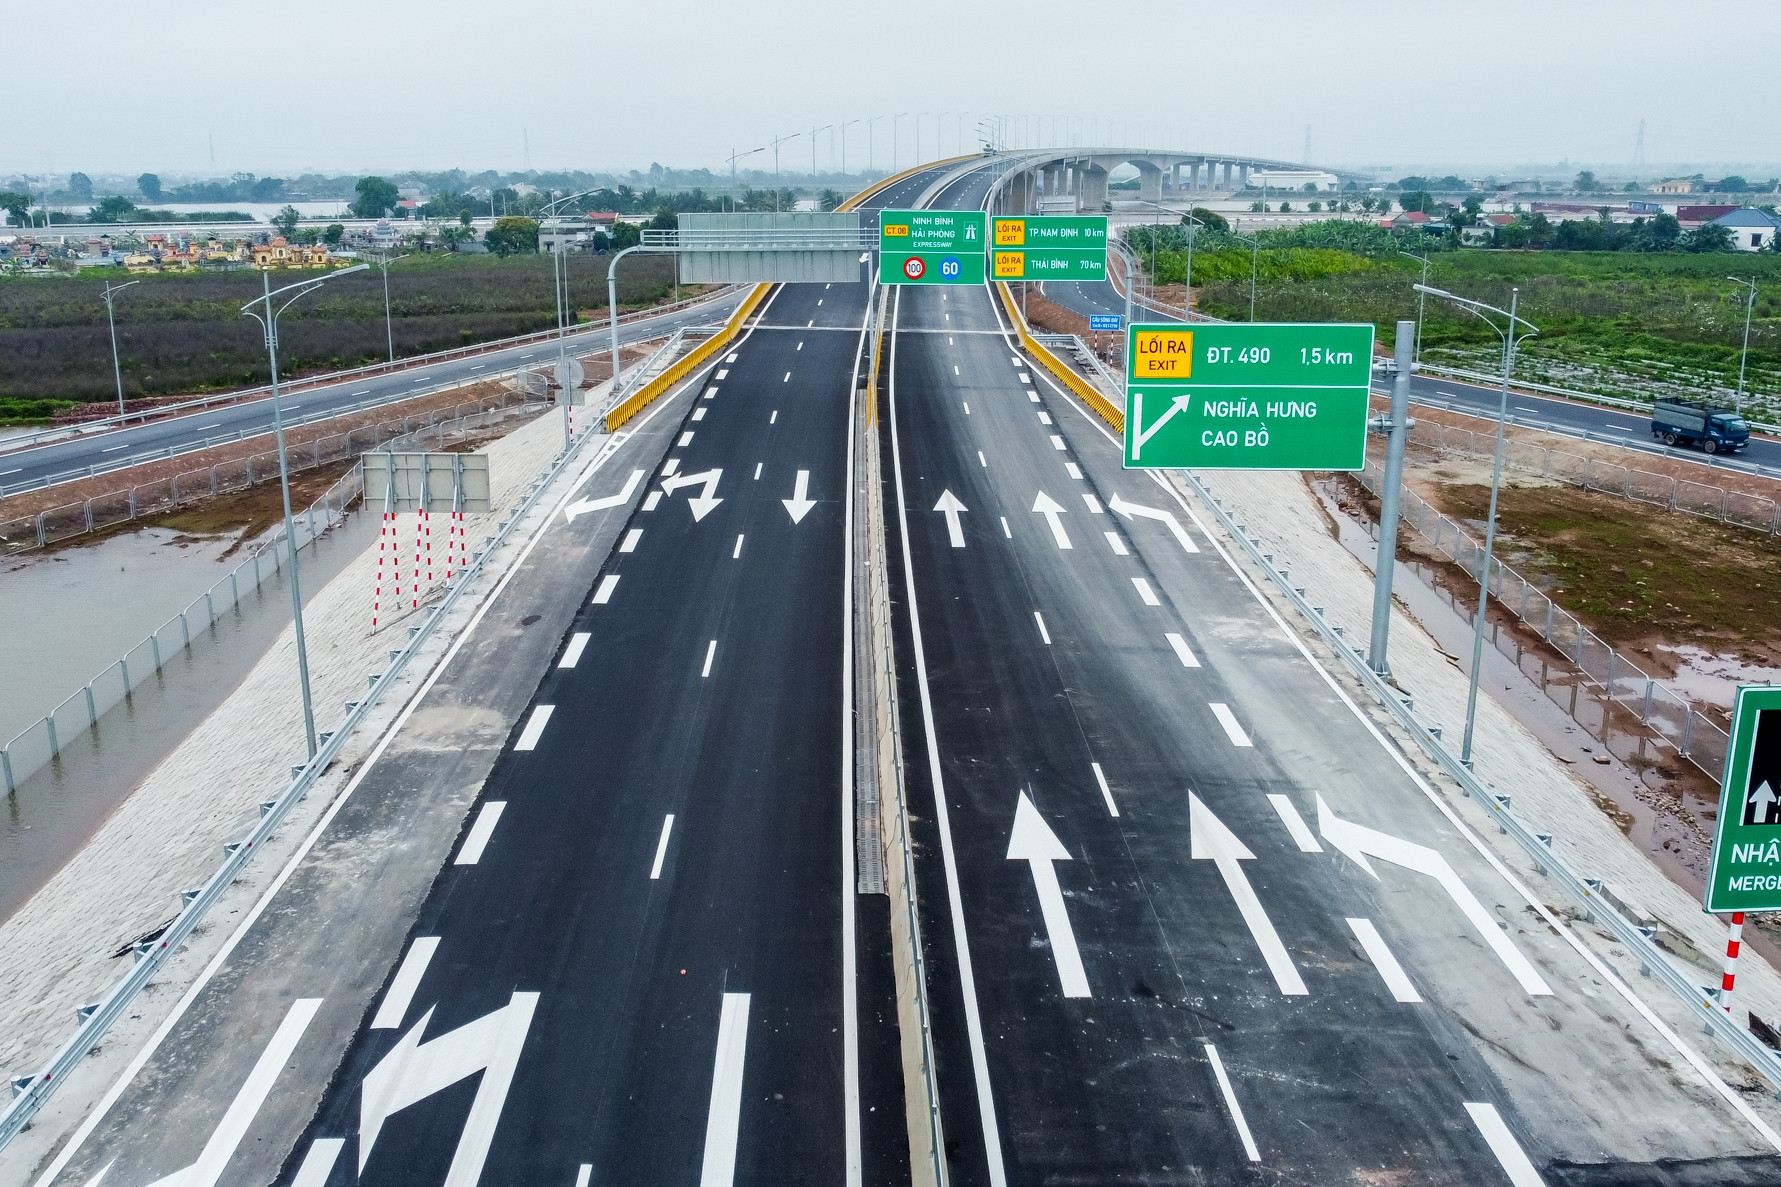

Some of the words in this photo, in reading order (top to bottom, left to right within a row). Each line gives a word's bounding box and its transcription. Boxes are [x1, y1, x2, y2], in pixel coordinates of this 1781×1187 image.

[912, 217, 932, 225] NINH
[934, 215, 954, 225] BÌNH
[911, 227, 926, 238] HẢI
[927, 228, 956, 238] PHÒNG
[997, 222, 1010, 233] LỐI
[1011, 225, 1022, 233] RA
[1060, 228, 1079, 239] ĐỊNH
[1084, 228, 1092, 237] 10
[1092, 228, 1104, 237] km
[997, 254, 1009, 265] LỐI
[1010, 256, 1022, 265] RA
[1031, 257, 1049, 269] THÁI
[1050, 258, 1069, 269] BÌNH
[1080, 260, 1090, 270] 70
[1089, 260, 1102, 270] km
[907, 263, 921, 273] 100
[942, 261, 959, 275] 60
[1140, 334, 1162, 354] LỐI
[1167, 340, 1187, 354] RA
[1207, 347, 1234, 364] ĐT.
[1238, 347, 1271, 364] 490
[1300, 347, 1321, 366] 1,5
[1325, 348, 1353, 365] km
[1149, 360, 1177, 371] EXIT
[1203, 397, 1260, 418] NGHĨA
[1266, 400, 1317, 418] HƯNG
[1201, 430, 1238, 447] CAO
[1244, 422, 1270, 447] BỒ
